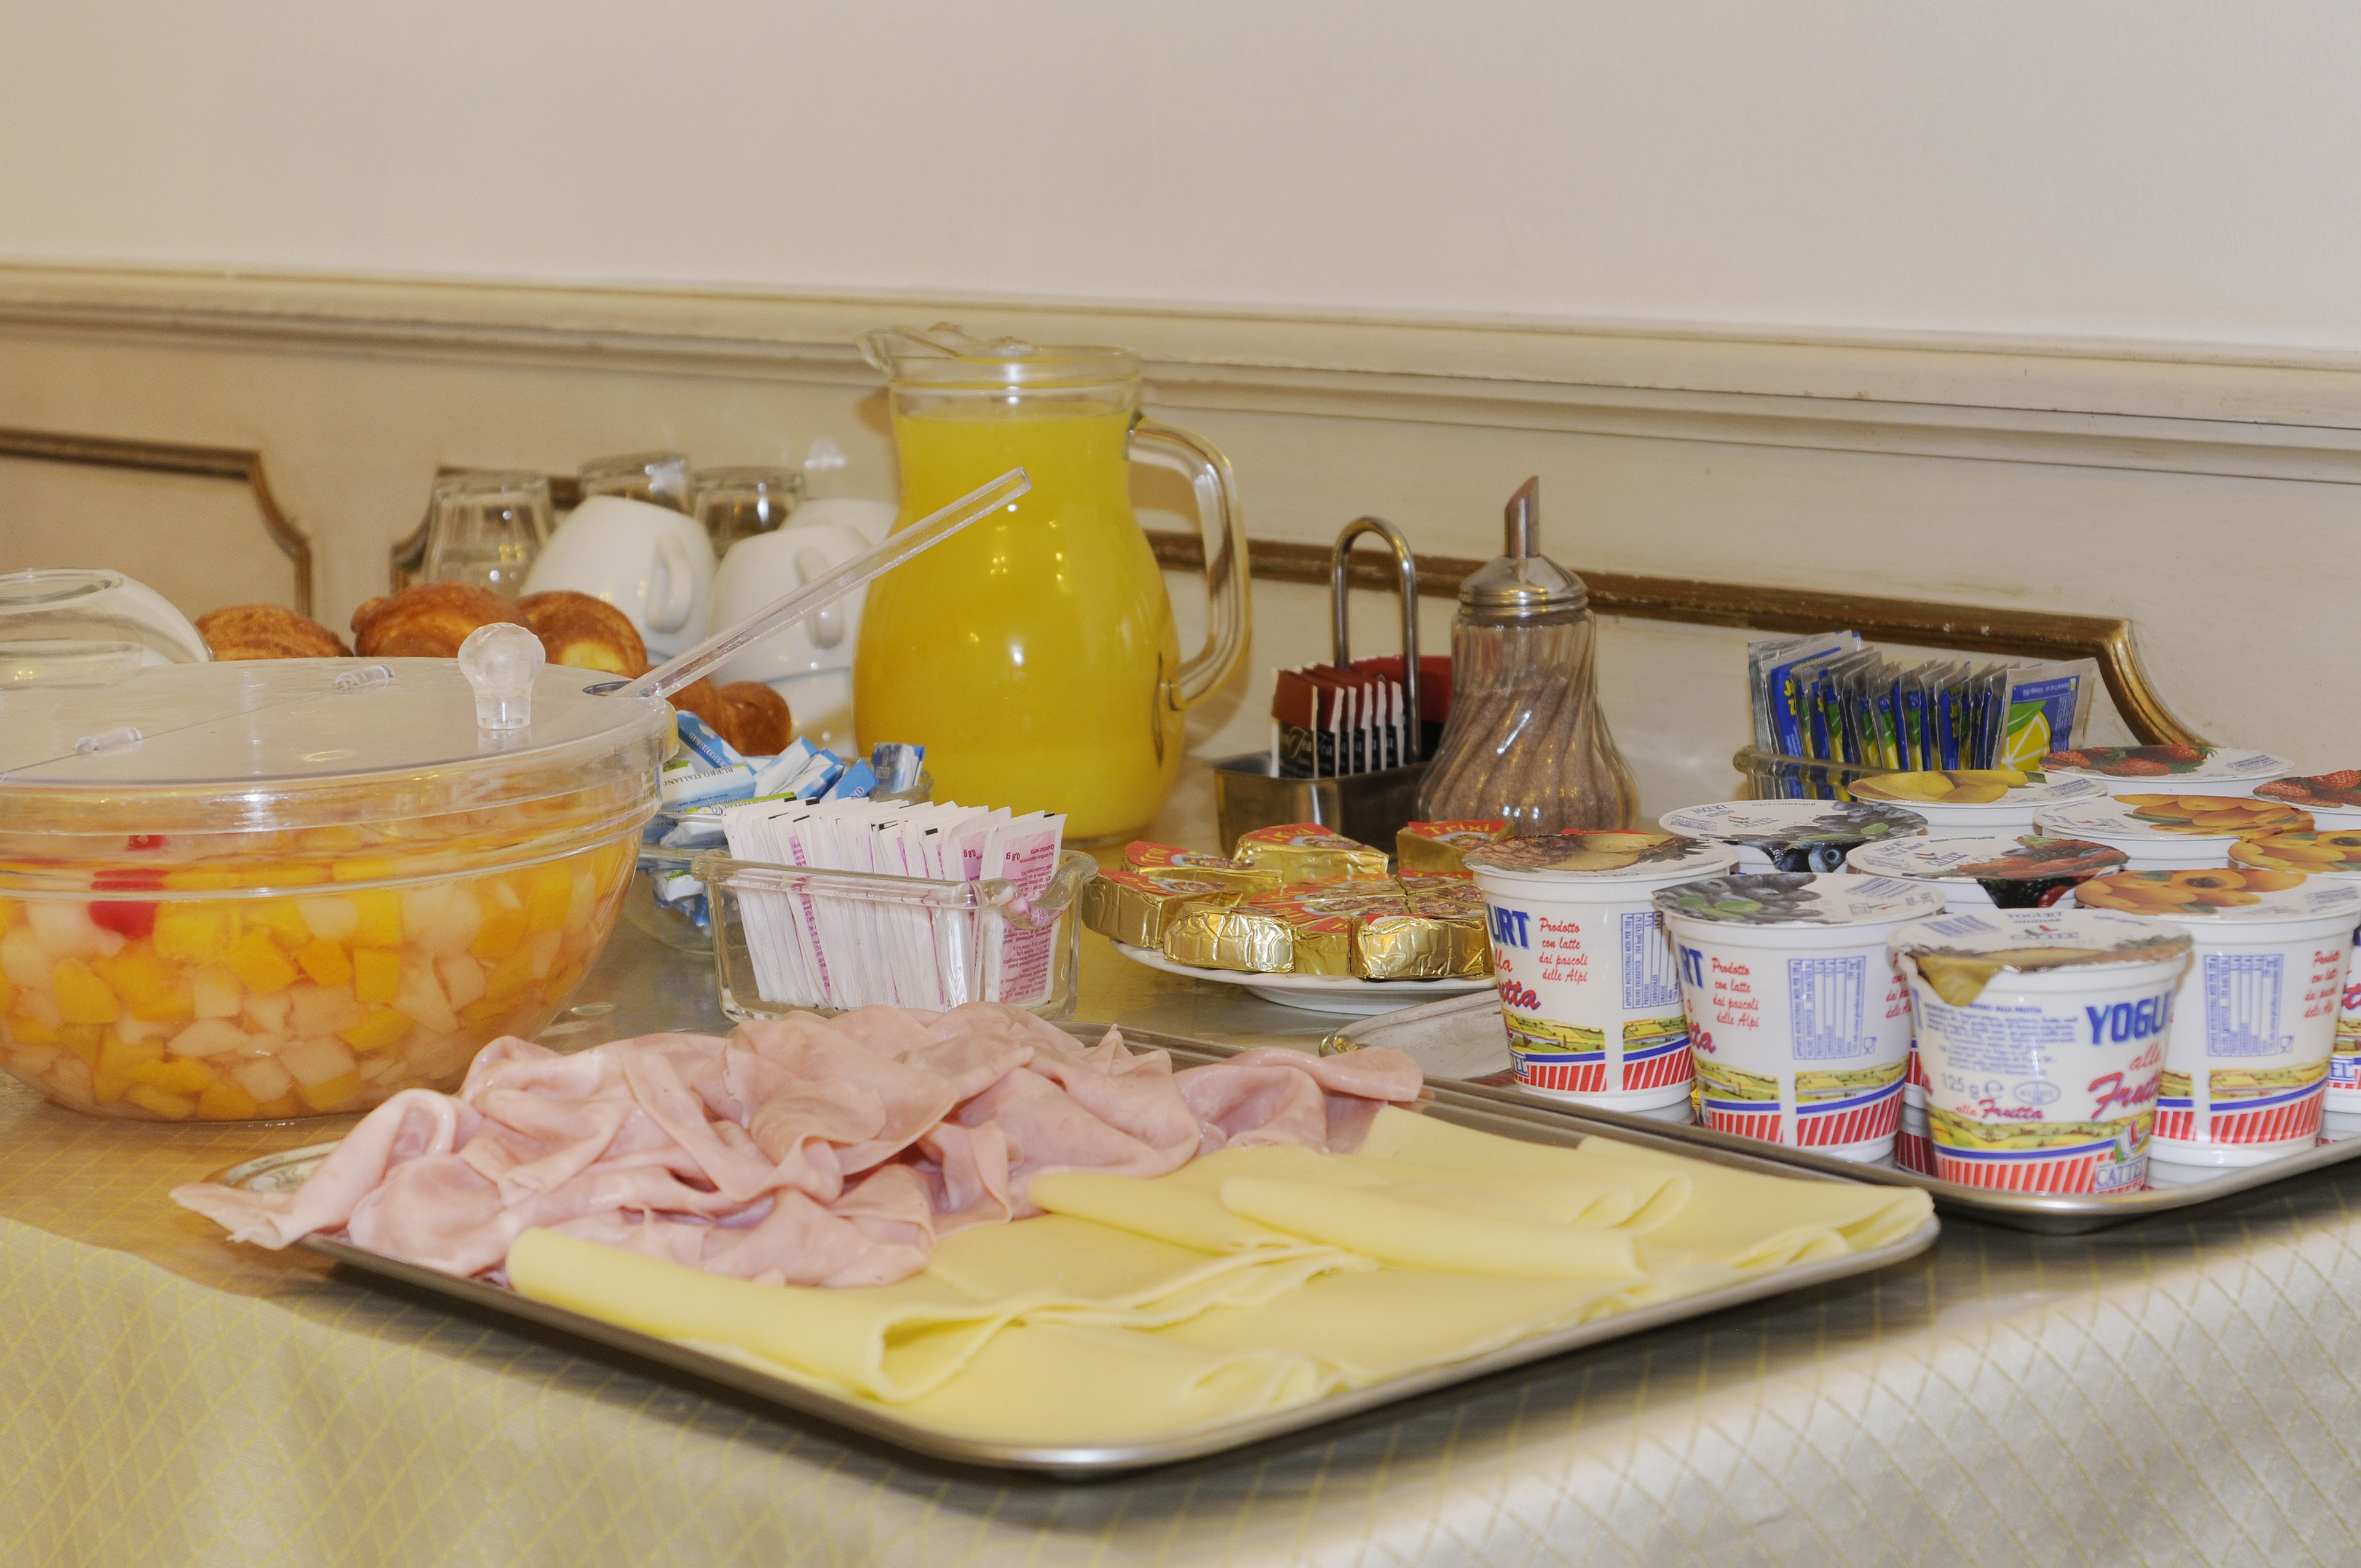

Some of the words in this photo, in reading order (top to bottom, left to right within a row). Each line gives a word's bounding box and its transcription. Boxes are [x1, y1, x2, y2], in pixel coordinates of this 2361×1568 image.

[1289, 727, 1312, 759] Tea
[704, 766, 734, 778] BURRO
[1423, 823, 1490, 835] Trixi
[1011, 852, 1020, 861] 0,8
[1540, 917, 1581, 933] Prodotto
[1542, 938, 1556, 949] con
[1559, 936, 1581, 950] latte
[1494, 948, 1513, 973] lla
[1539, 952, 1553, 965] dai
[1556, 953, 1588, 969] pascoli
[1712, 957, 1750, 976] Prodotto
[1543, 968, 1562, 981] delle
[1565, 968, 1588, 985] Alpi
[1715, 981, 1728, 991] con
[1731, 979, 1751, 993] latte
[1713, 993, 1725, 1007] dai
[1728, 997, 1759, 1013] pascoli
[1738, 1012, 1759, 1031] Alpi
[1943, 1073, 1966, 1092] 125
[1969, 1084, 1979, 1099] g
[1956, 1104, 1978, 1117] alla
[1979, 1098, 2043, 1119] Frutta
